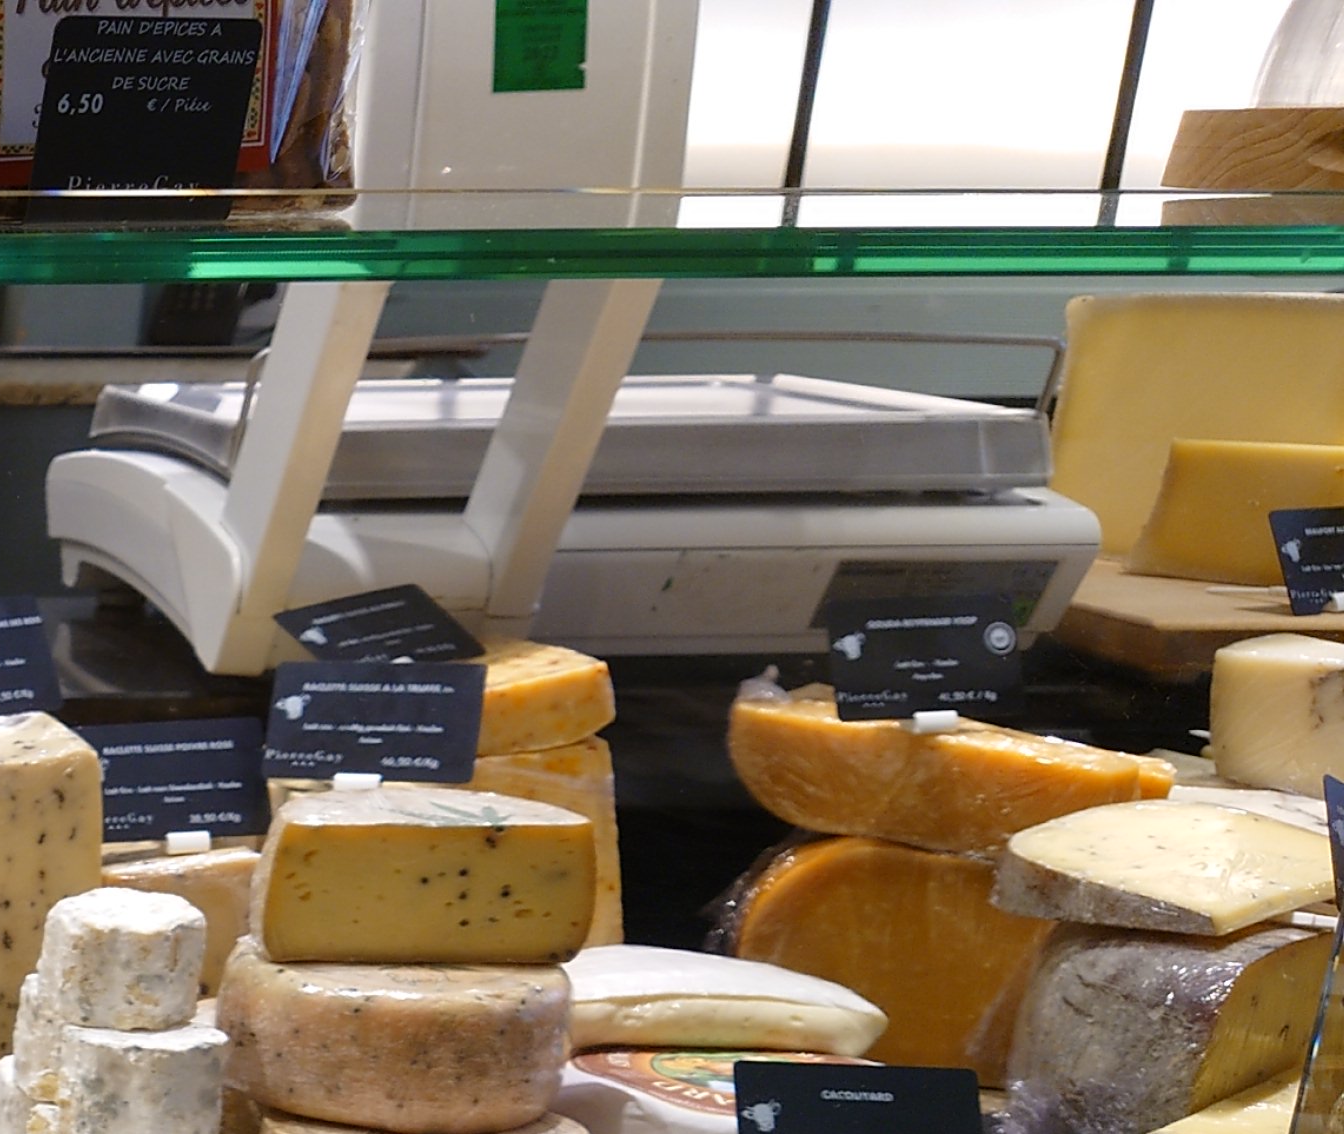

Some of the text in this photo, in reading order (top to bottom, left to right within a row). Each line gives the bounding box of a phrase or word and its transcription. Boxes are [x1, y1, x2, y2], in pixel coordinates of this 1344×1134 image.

[97, 20, 221, 36] PAIN D'EPICES A
[54, 48, 255, 64] L'ANCIENNE AVEC GRAINS
[112, 76, 190, 91] DE SUCRE
[58, 94, 103, 115] 6,50
